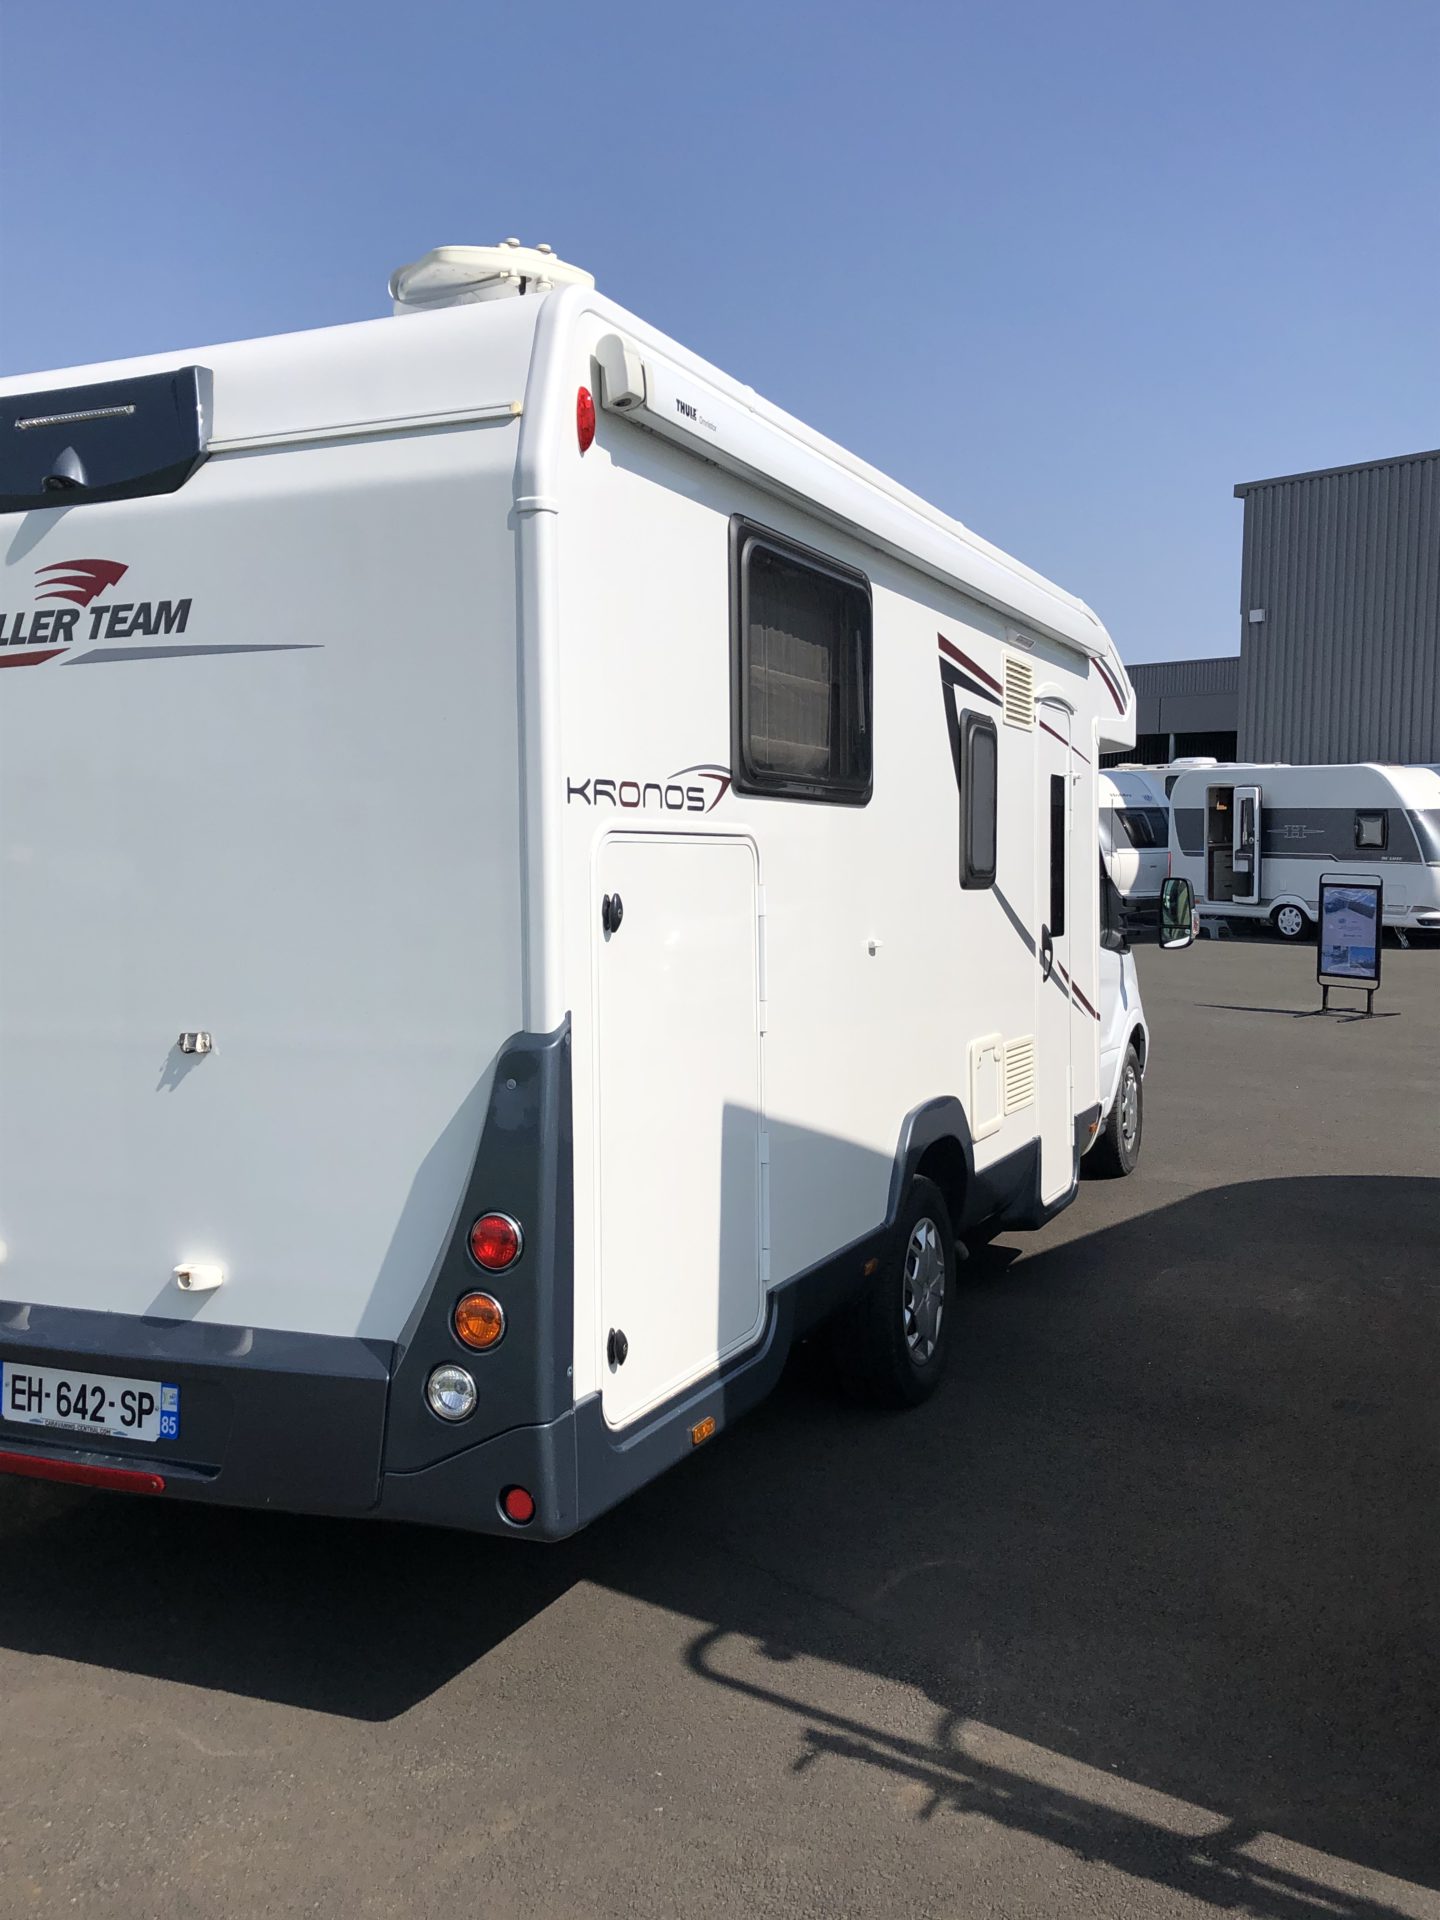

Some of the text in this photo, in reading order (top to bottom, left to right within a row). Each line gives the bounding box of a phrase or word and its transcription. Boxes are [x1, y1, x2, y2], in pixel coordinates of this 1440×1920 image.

[676, 398, 697, 418] THULE
[88, 598, 193, 640] TEAM
[11, 1374, 155, 1429] EH-642-SP
[161, 1415, 177, 1435] 85
